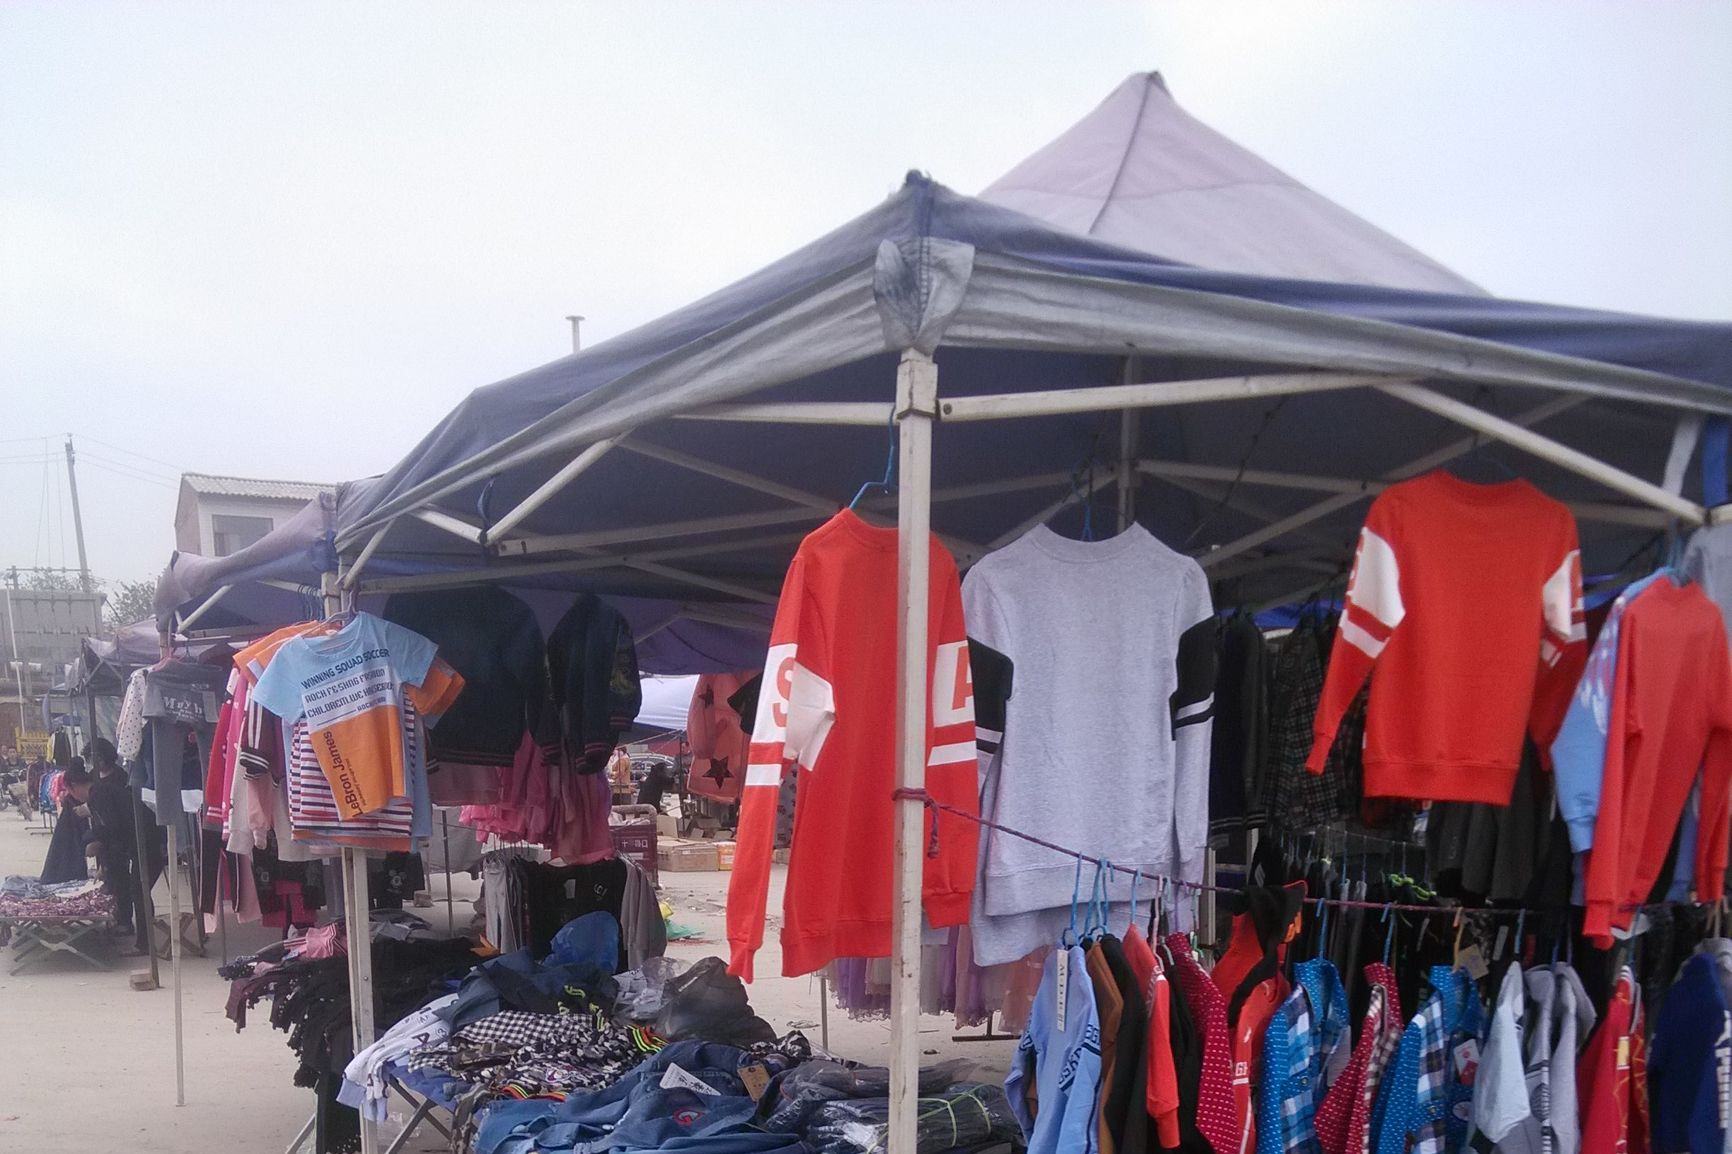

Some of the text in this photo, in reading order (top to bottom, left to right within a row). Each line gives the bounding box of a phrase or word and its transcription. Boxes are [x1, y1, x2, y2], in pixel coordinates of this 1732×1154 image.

[301, 668, 336, 689] WINNING
[363, 648, 390, 662] SOCCER
[323, 731, 344, 771] James
[340, 773, 364, 818] LeBron
